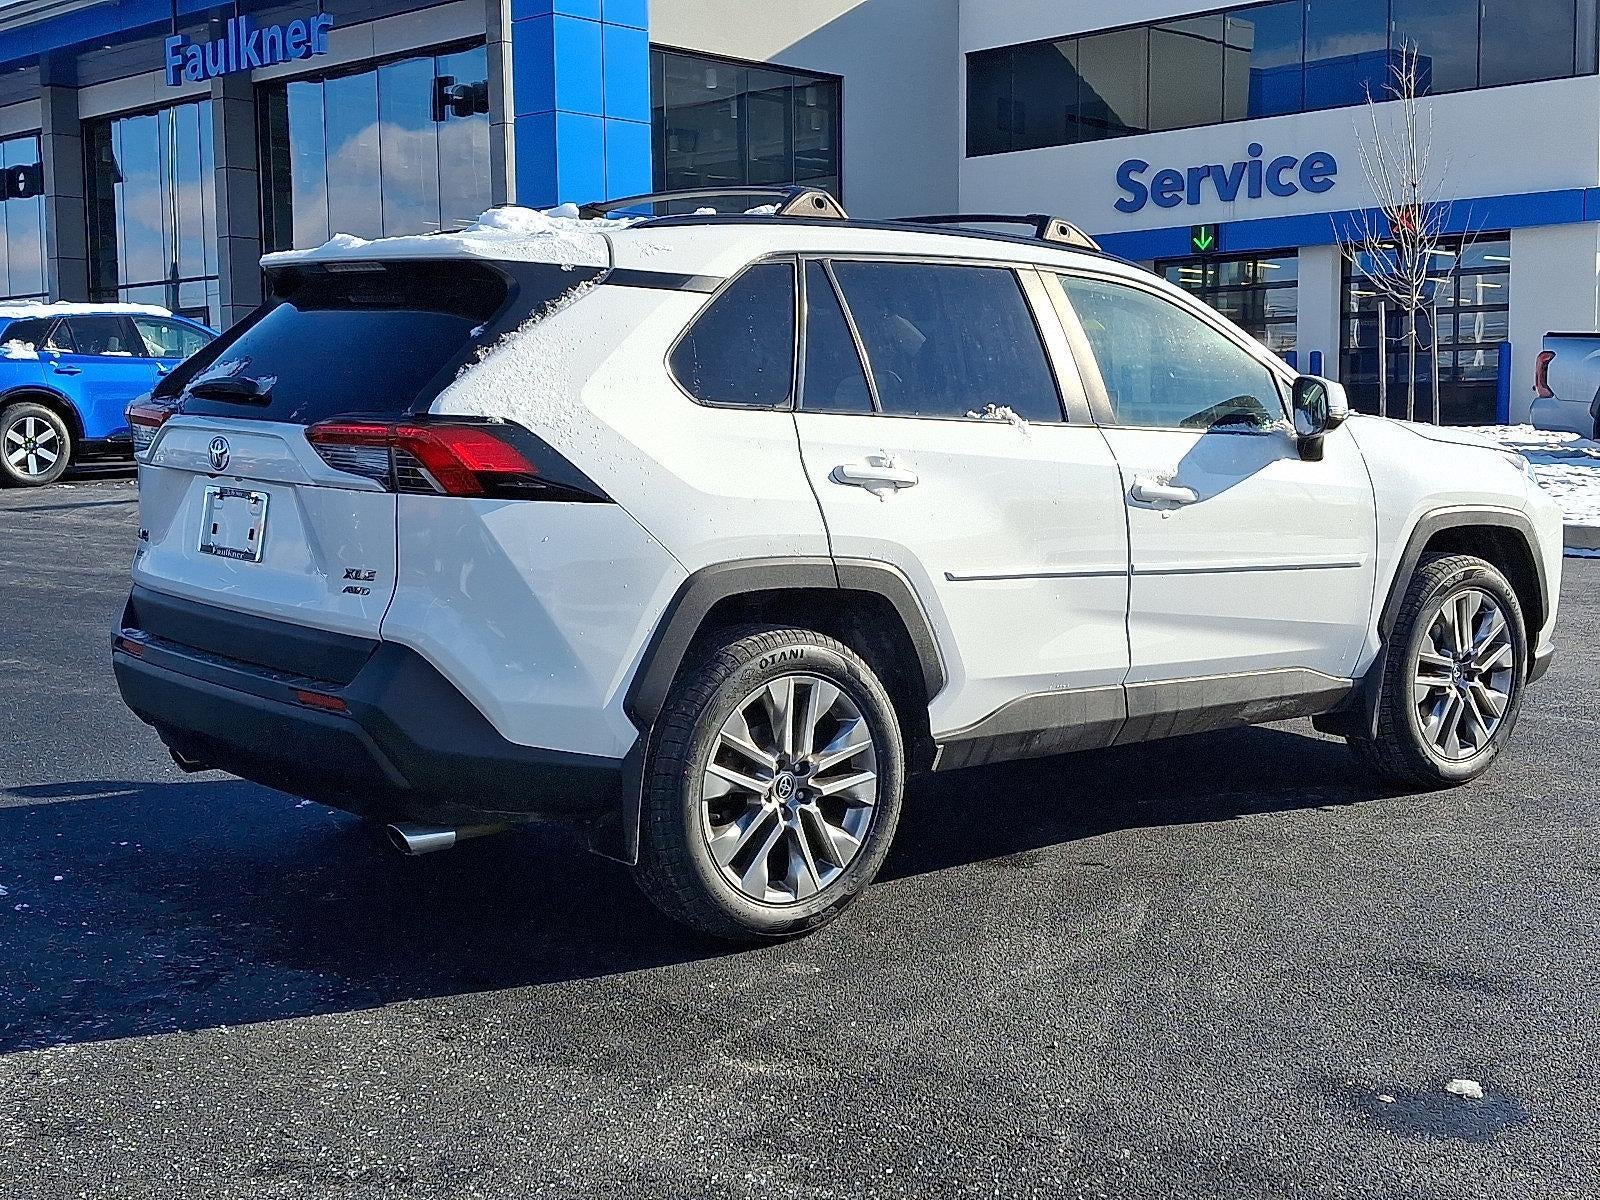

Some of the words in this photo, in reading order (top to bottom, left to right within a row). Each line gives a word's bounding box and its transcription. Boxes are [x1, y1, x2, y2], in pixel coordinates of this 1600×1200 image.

[165, 13, 334, 86] Faulkner
[1114, 142, 1338, 213] Service
[343, 567, 377, 581] XLE
[342, 586, 371, 596] AWD
[759, 648, 804, 669] OTANI
